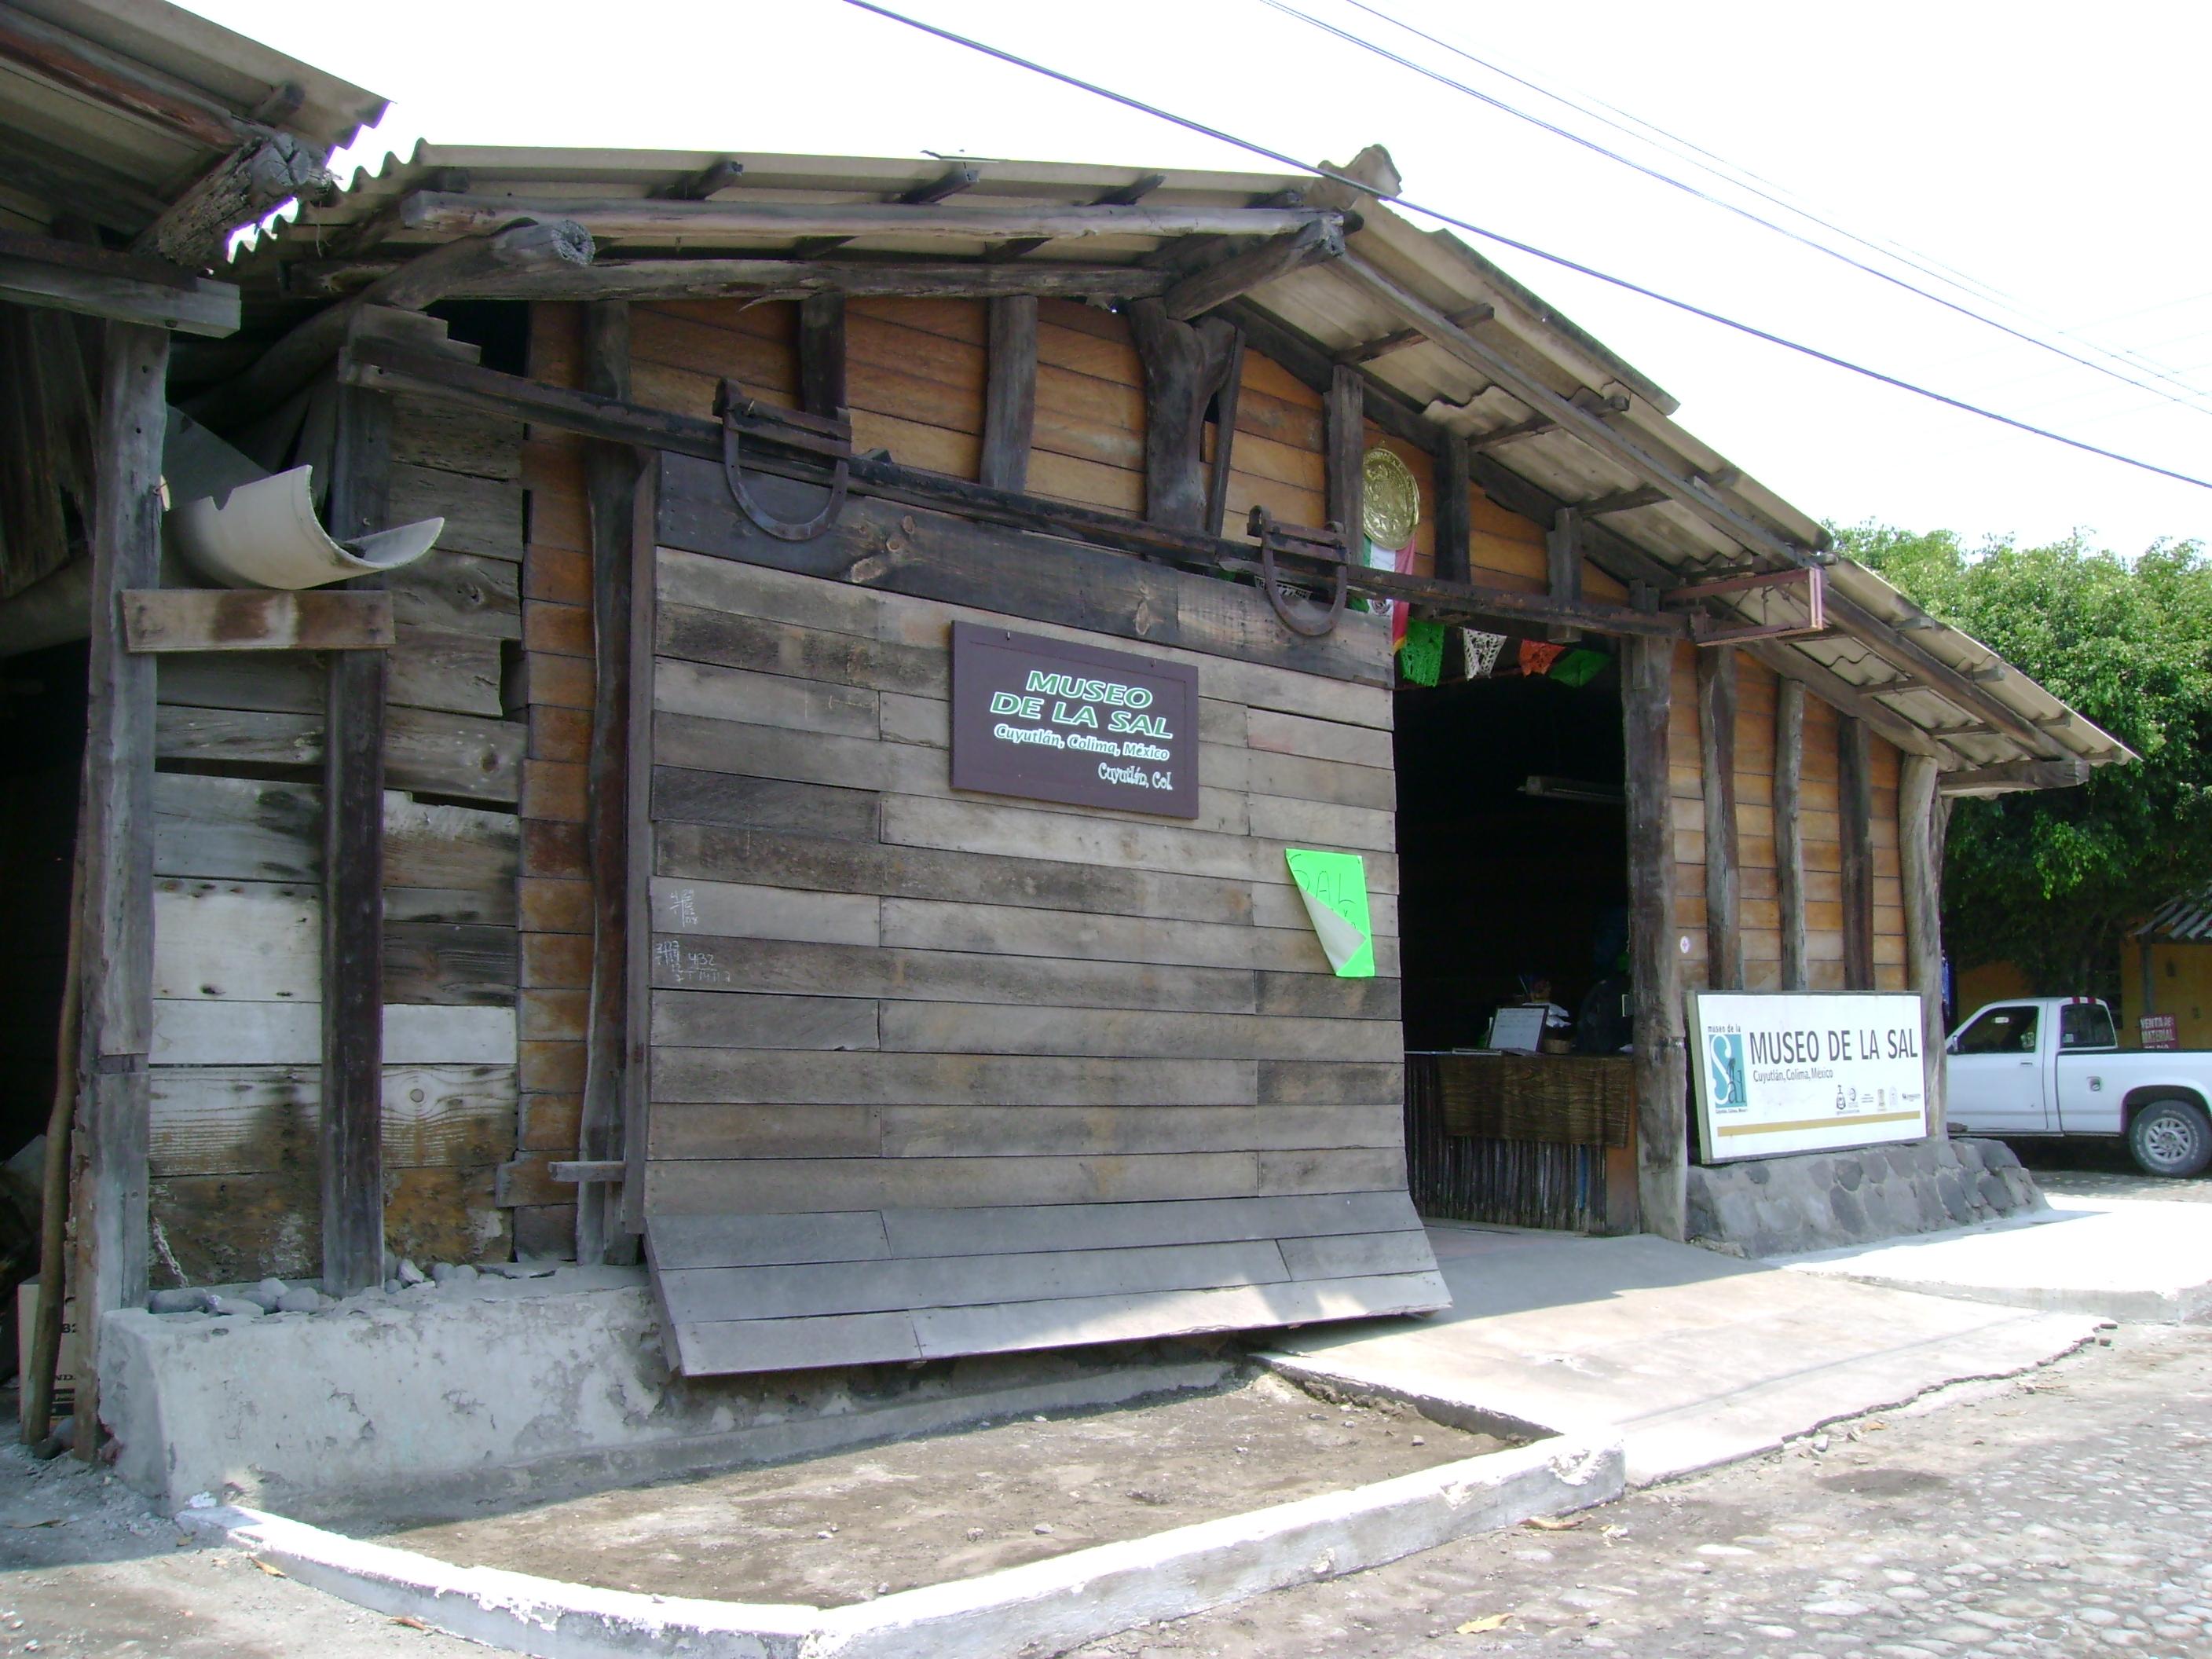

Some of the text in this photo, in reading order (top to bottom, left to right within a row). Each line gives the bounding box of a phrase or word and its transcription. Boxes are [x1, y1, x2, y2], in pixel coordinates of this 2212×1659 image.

[1026, 670, 1153, 709] MUSEO
[990, 691, 1174, 739] DE LA SAL
[994, 723, 1170, 761] Cuyutlán, Colima, México
[1098, 762, 1149, 788] Cuyutlán,
[1749, 1028, 1918, 1064] MUSEO DE LA SAL
[1786, 1068, 1811, 1081] Colima,
